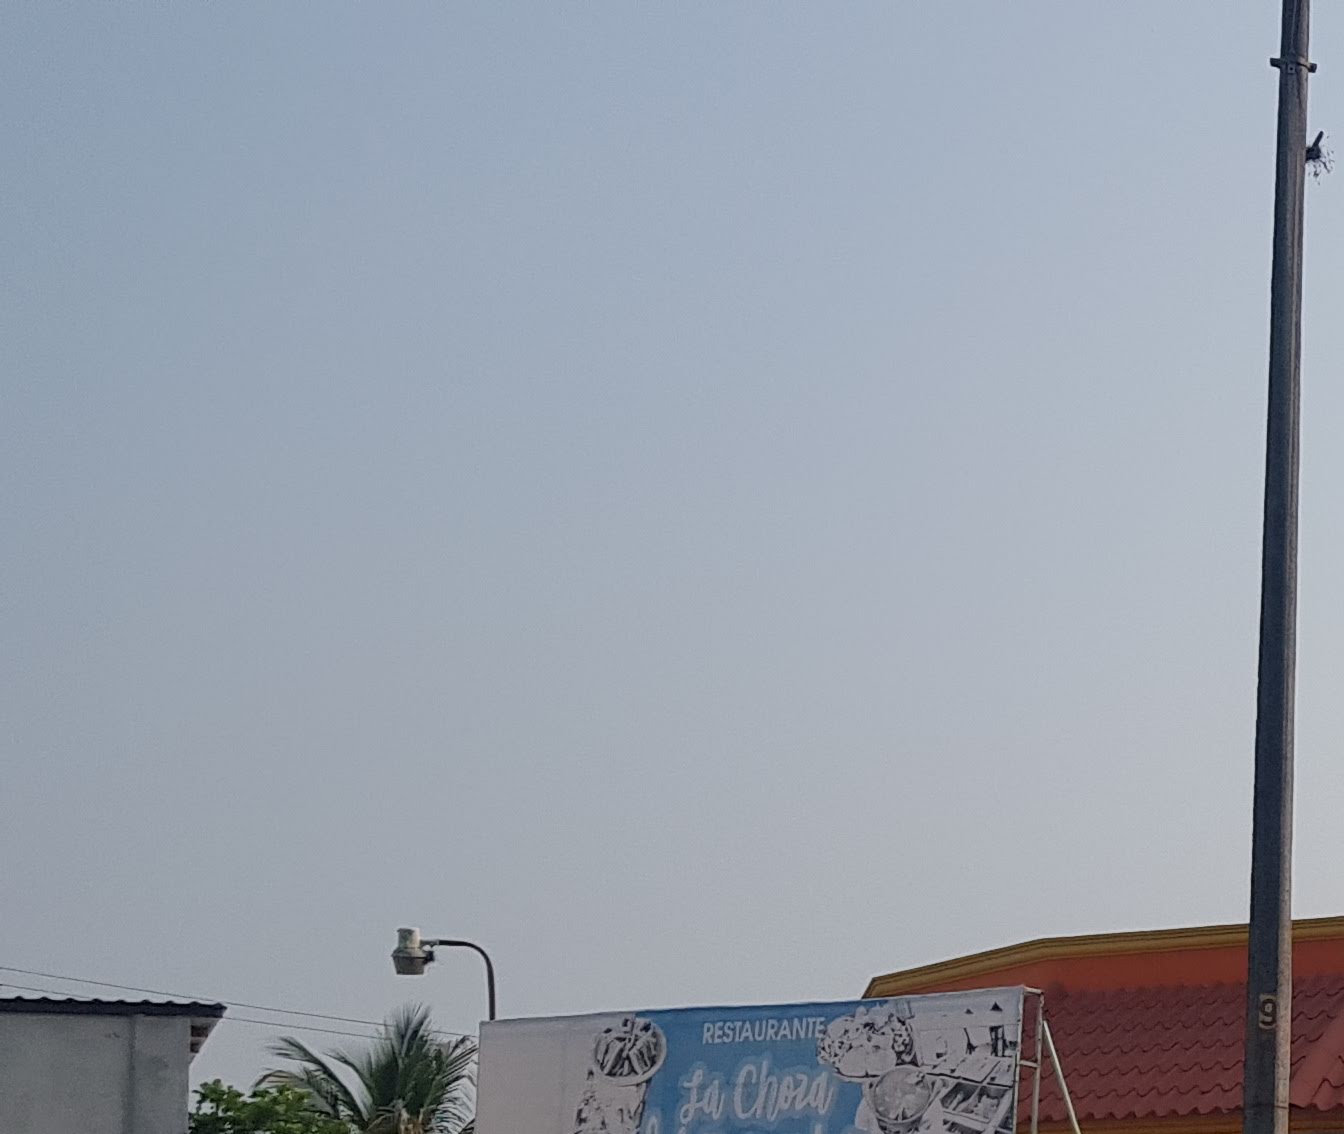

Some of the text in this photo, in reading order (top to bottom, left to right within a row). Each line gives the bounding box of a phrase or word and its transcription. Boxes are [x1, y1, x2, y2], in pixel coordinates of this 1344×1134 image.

[1260, 998, 1277, 1027] 9
[702, 1016, 828, 1045] RESTAURANTE
[680, 1057, 834, 1125] La Choza
